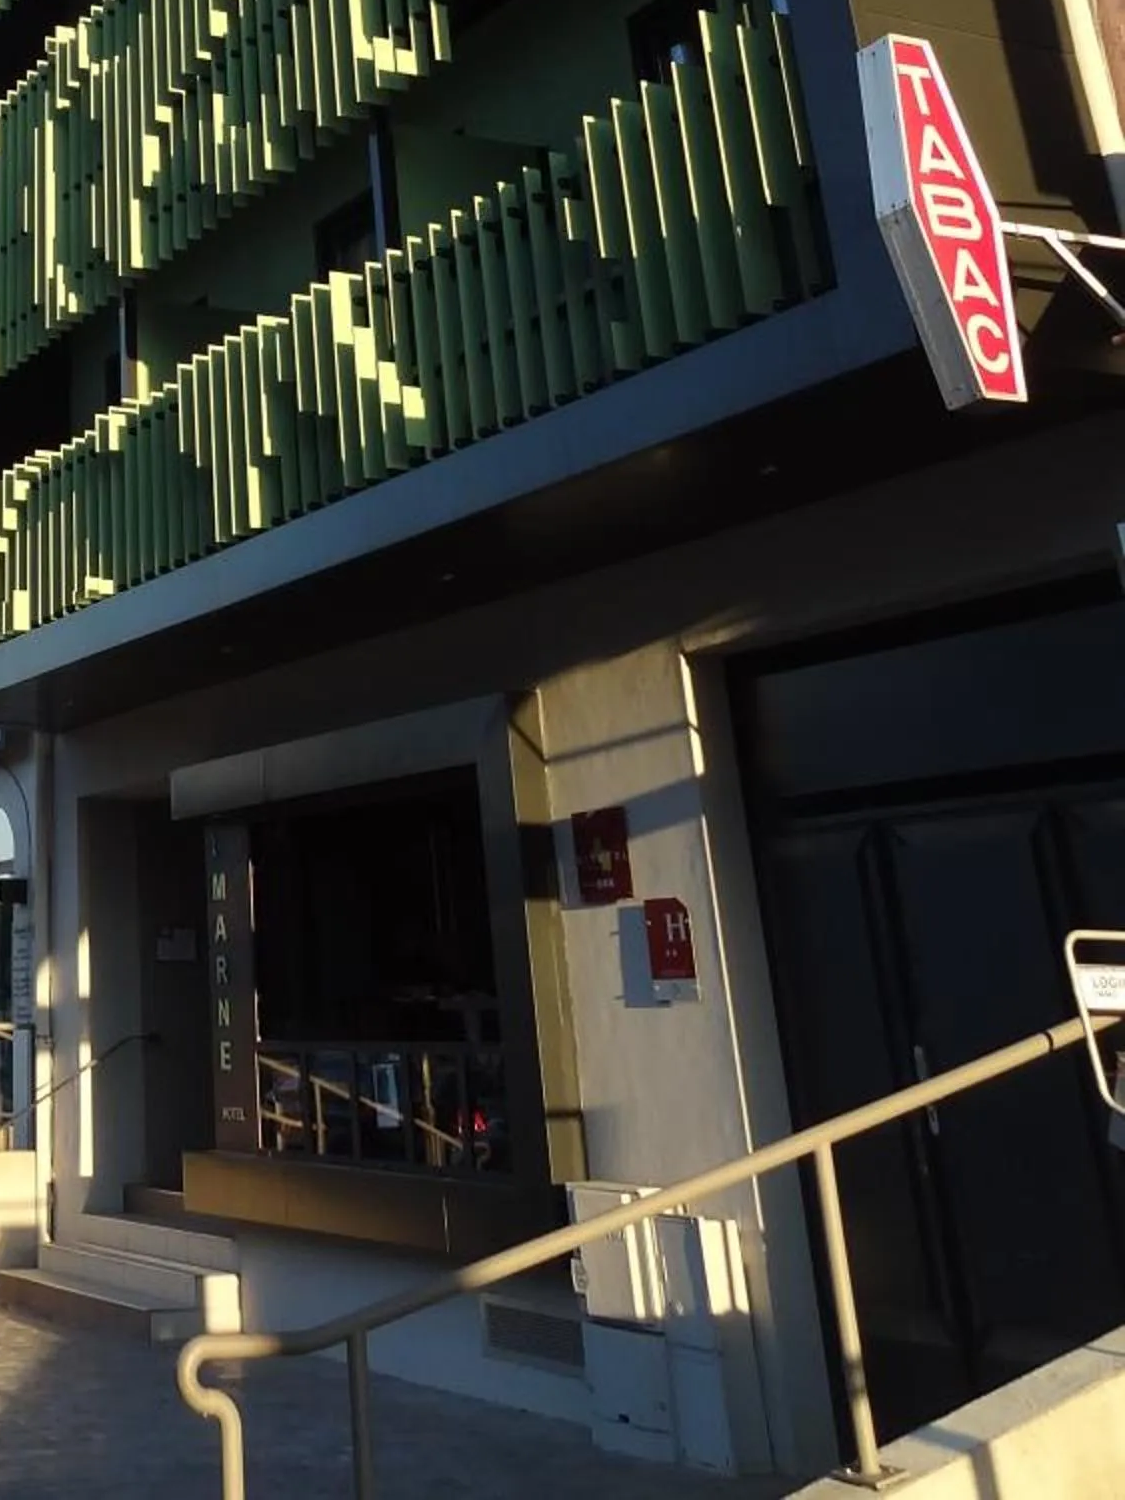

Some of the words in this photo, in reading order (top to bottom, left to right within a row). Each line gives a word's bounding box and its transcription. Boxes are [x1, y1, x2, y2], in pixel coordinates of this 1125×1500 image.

[897, 63, 1011, 374] TABAC
[212, 873, 232, 1070] MARNE
[665, 913, 686, 942] H
